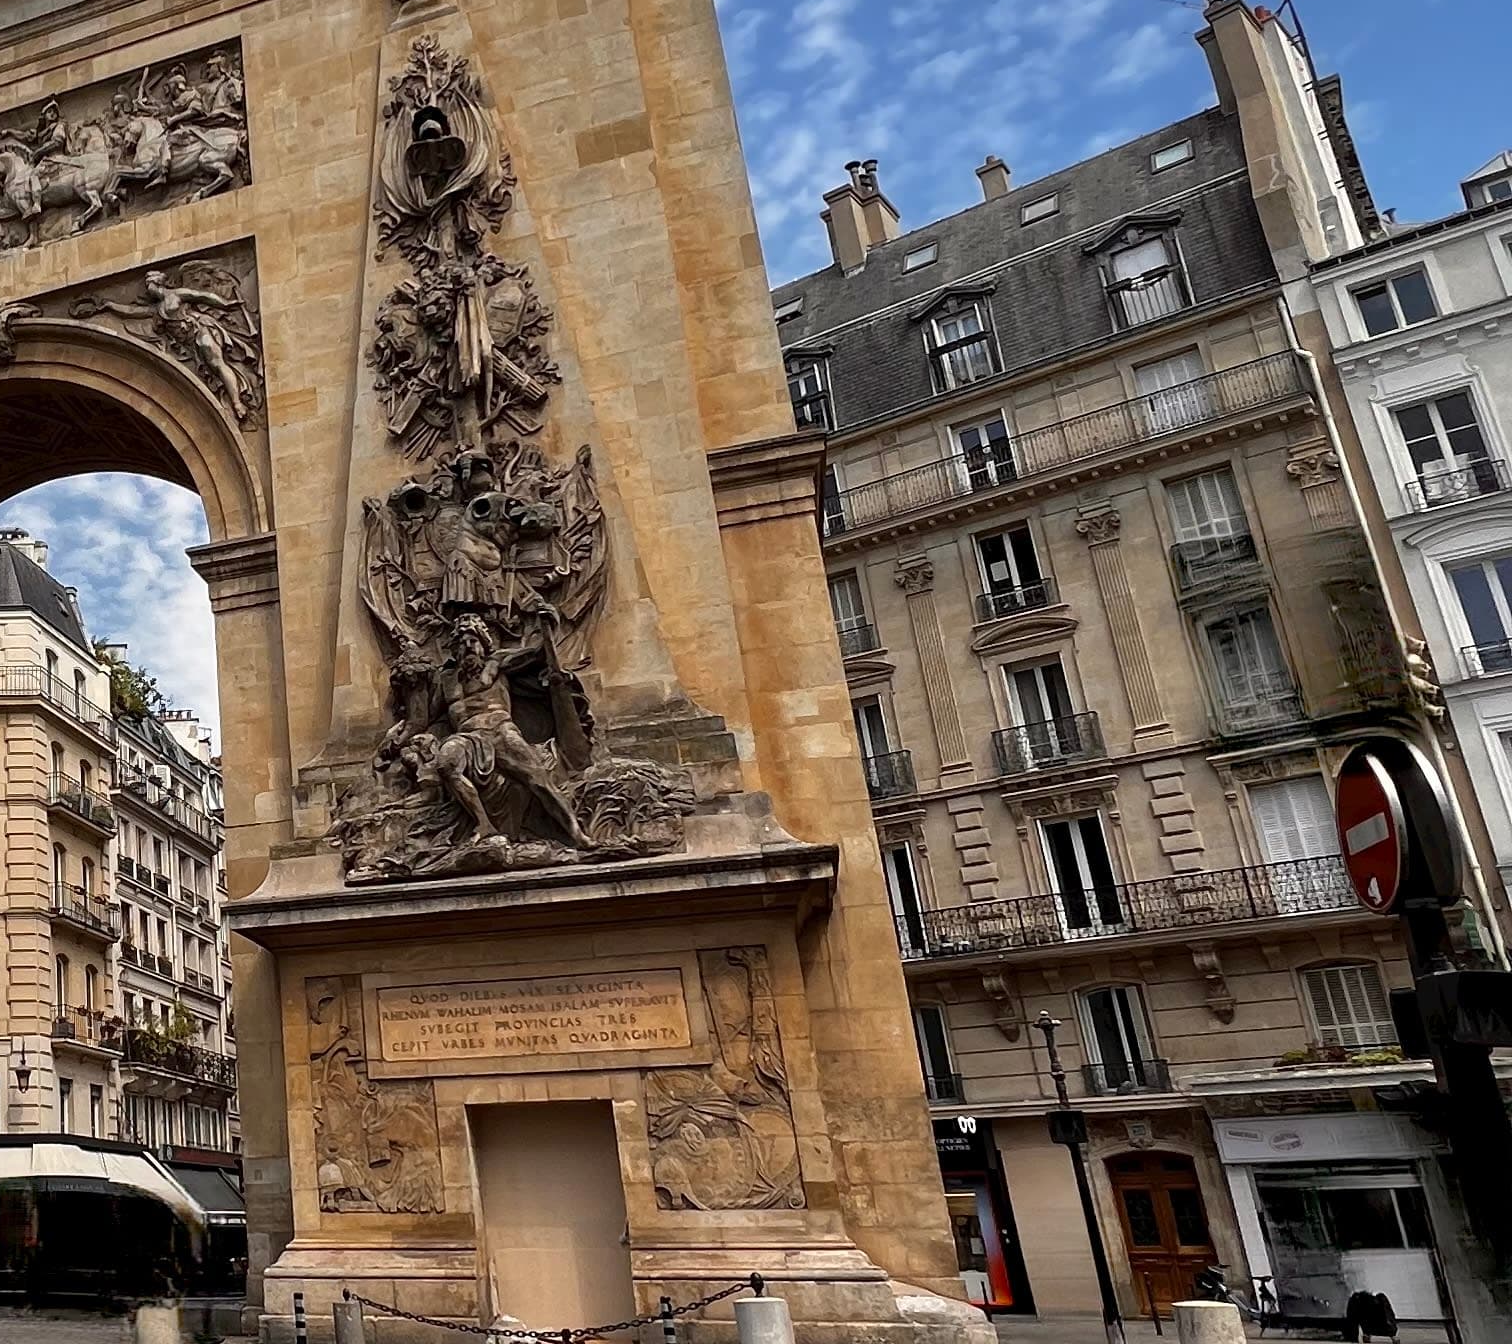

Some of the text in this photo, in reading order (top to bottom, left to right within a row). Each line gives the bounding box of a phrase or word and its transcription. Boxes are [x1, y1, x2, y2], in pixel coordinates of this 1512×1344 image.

[420, 1013, 637, 1036] SVBEGIT PROVINCIAS TRES
[391, 1027, 678, 1054] CEPIT VRBES MVNITAS QVADRAGINTA
